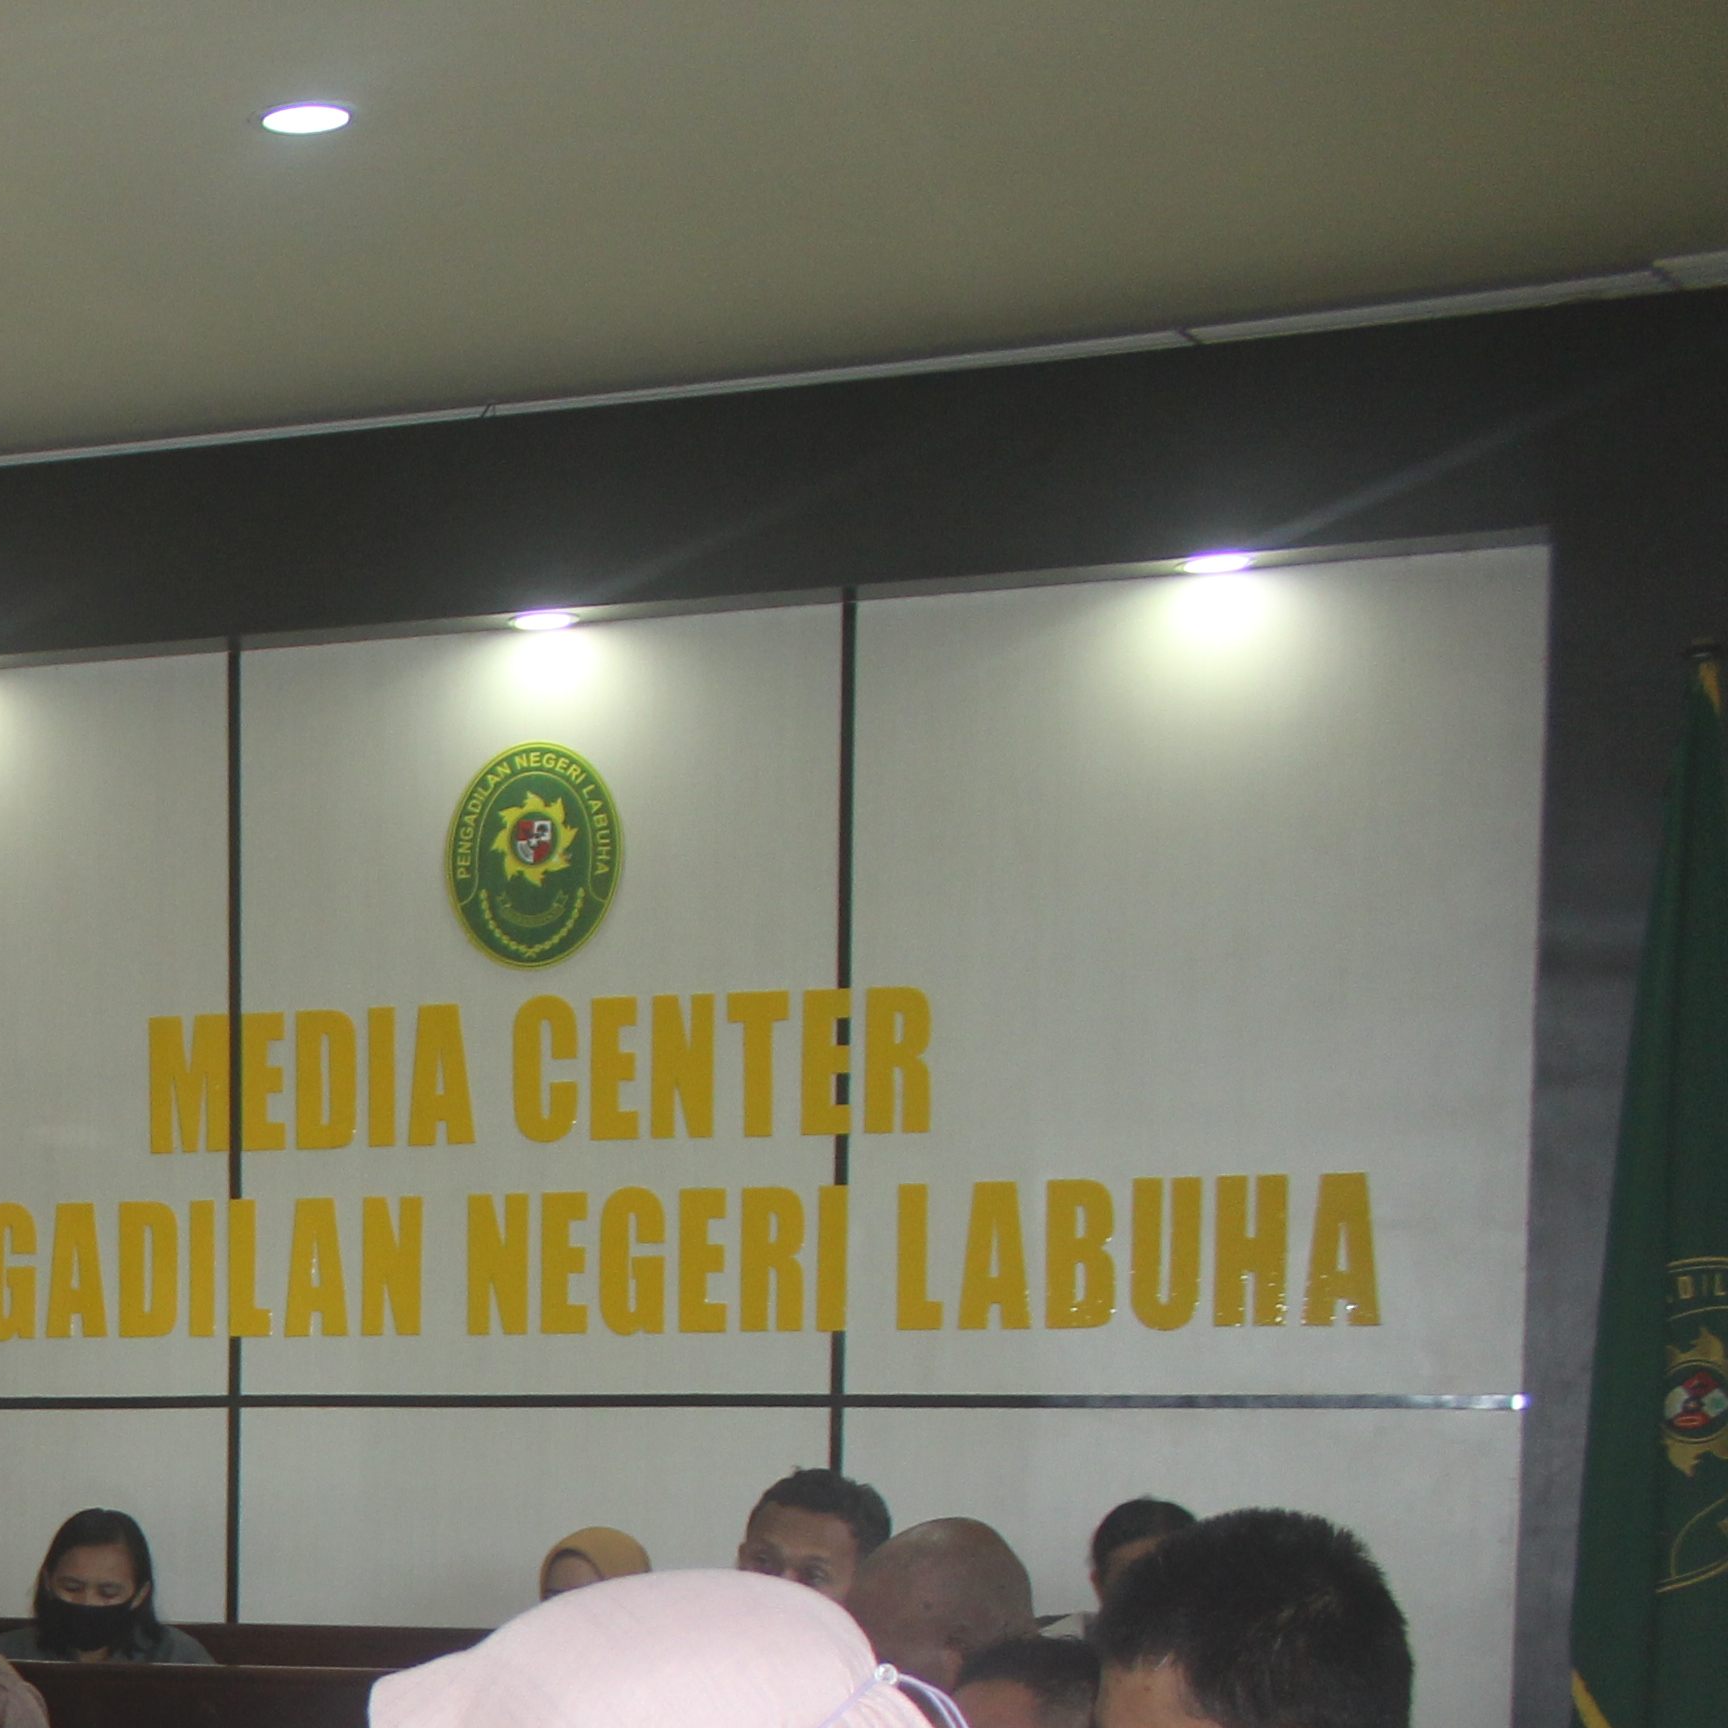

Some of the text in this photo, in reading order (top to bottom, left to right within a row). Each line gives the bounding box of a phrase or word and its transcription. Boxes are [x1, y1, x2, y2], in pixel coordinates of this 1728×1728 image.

[455, 751, 610, 880] PENGADILAN NEGERI LABUHA
[148, 986, 932, 1155] MEDIA CENTER
[468, 1184, 848, 1336] NEGERI
[896, 1172, 1382, 1332] LABUHA
